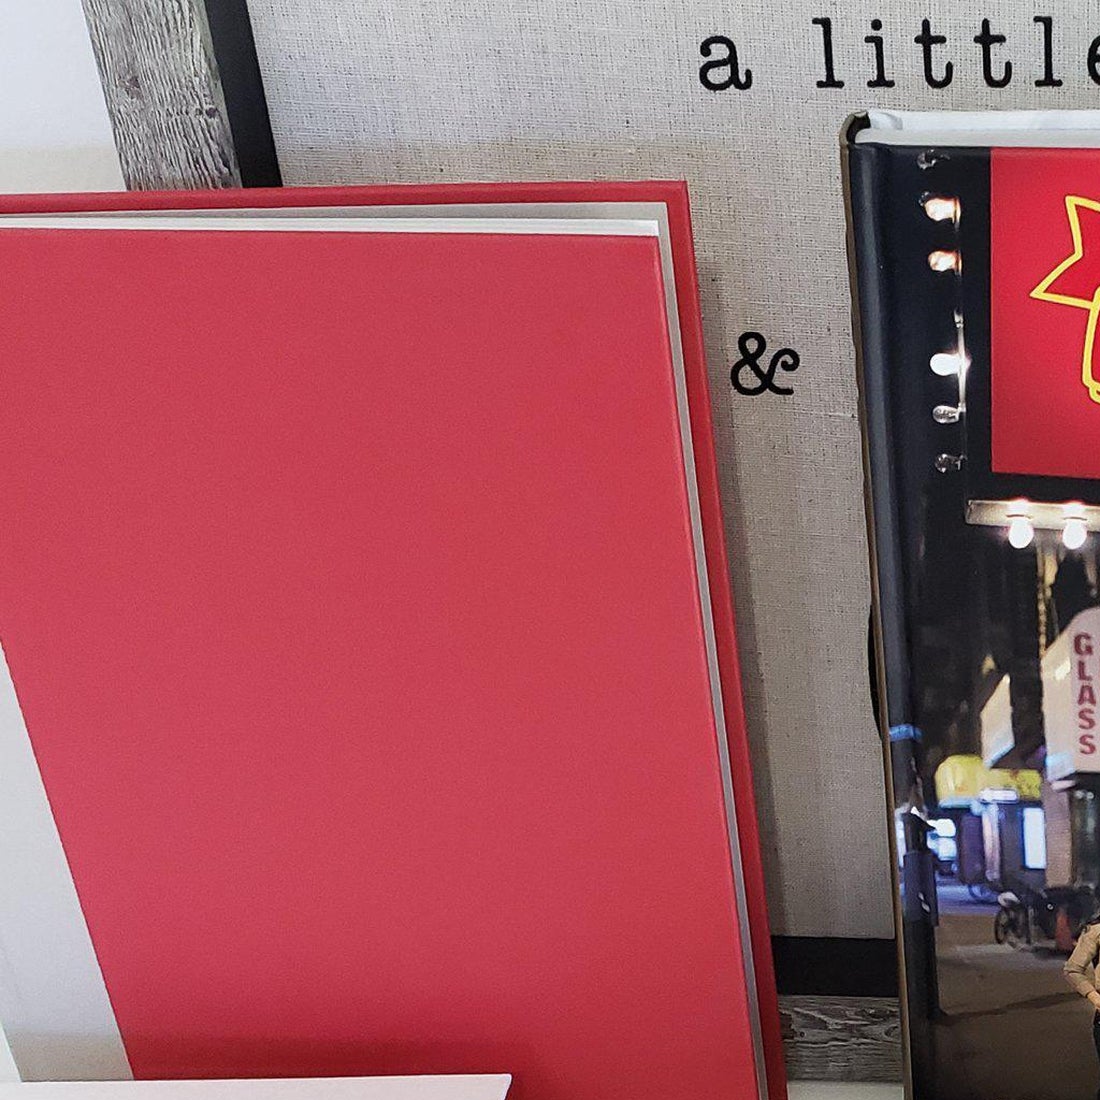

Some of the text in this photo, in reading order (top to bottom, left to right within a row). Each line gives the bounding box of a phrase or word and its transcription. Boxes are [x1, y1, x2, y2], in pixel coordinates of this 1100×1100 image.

[698, 35, 753, 92] a
[730, 331, 800, 396] &
[1073, 632, 1097, 754] GLASS
